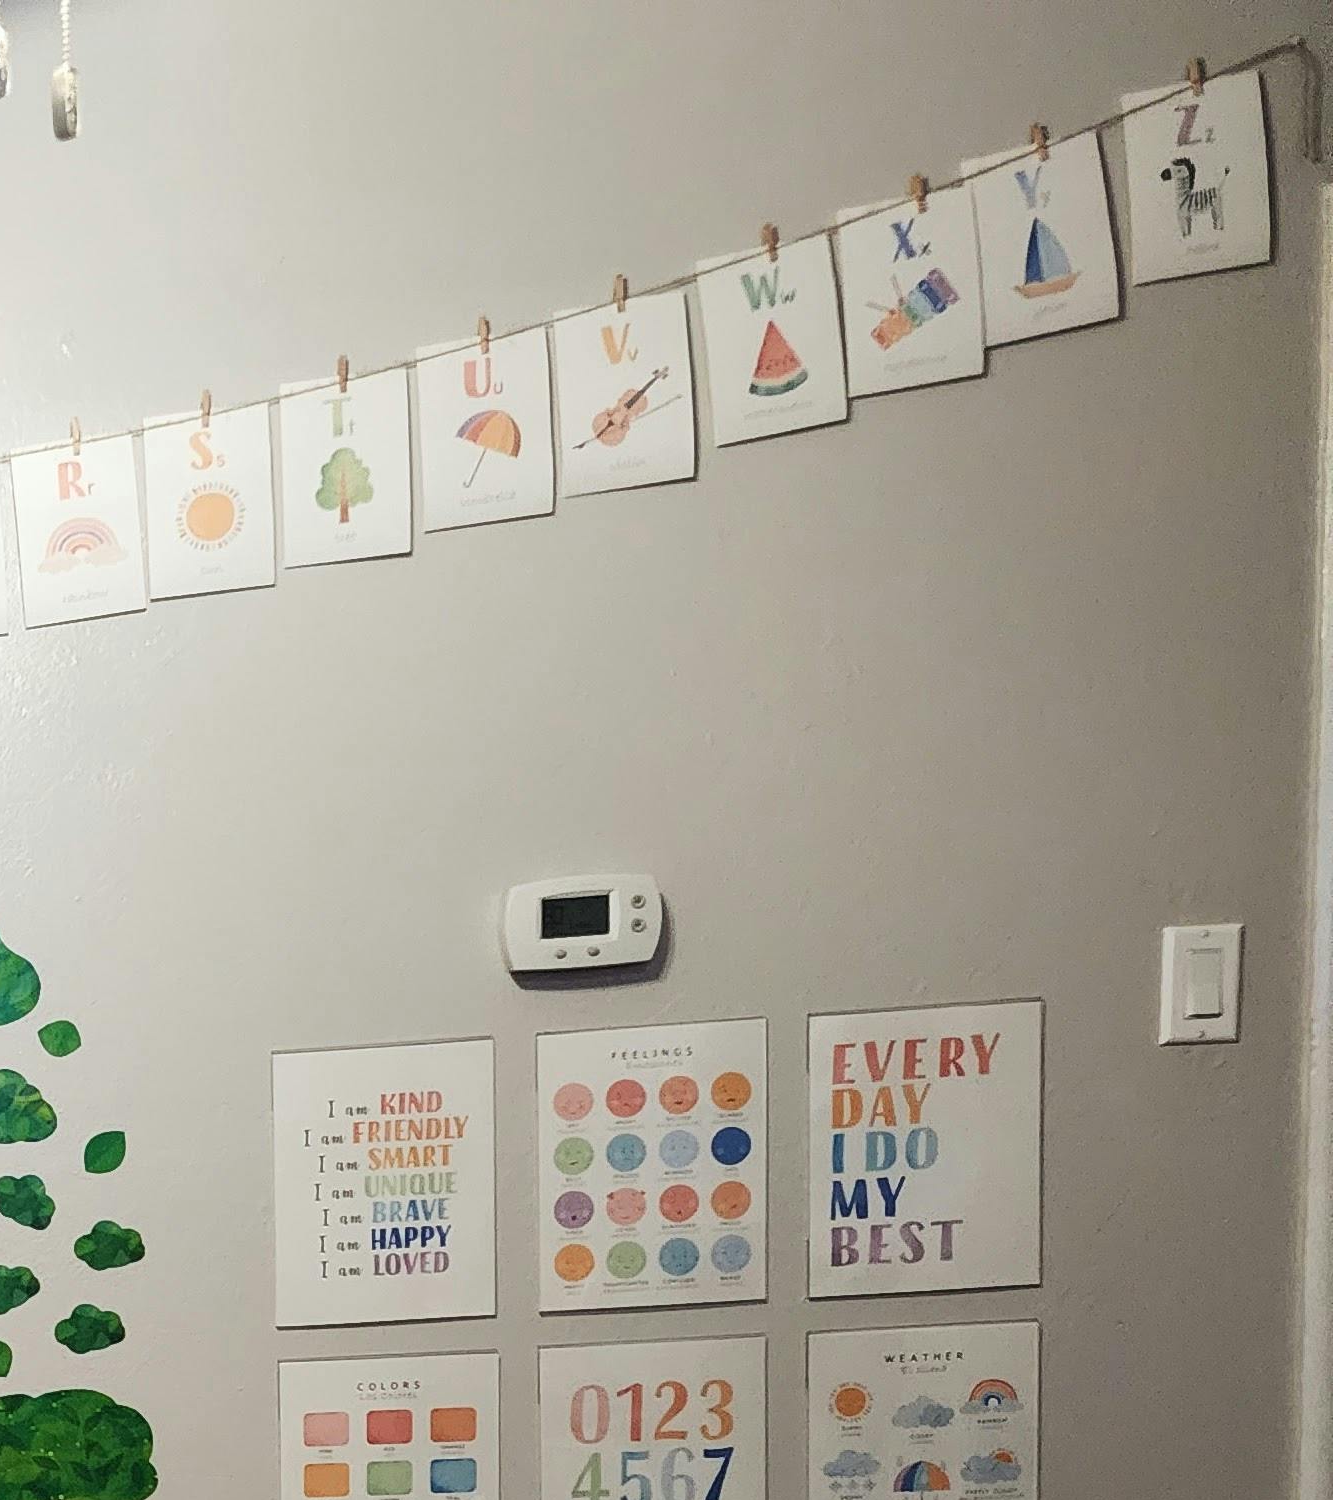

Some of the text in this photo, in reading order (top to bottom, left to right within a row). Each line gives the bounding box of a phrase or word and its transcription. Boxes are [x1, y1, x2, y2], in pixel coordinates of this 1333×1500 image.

[189, 431, 225, 471] Ss
[57, 461, 95, 501] Rr
[610, 1046, 694, 1061] FEELINGS
[833, 1031, 1002, 1085] EVERY
[328, 1089, 444, 1119] I am KIND
[832, 1083, 932, 1129] DAY
[303, 1115, 469, 1148] I am FRIENDLY
[318, 1144, 452, 1174] I am SMART
[832, 1126, 940, 1174] I DO
[314, 1172, 459, 1202] I am UNIQUE
[829, 1175, 908, 1221] MY
[322, 1198, 451, 1228] I am BRAVE
[319, 1224, 452, 1254] I am HAPPY
[830, 1219, 964, 1268] BEST
[321, 1250, 451, 1279] I am LOVED
[884, 1351, 965, 1364] WEATHER
[356, 1380, 421, 1394] COLORS
